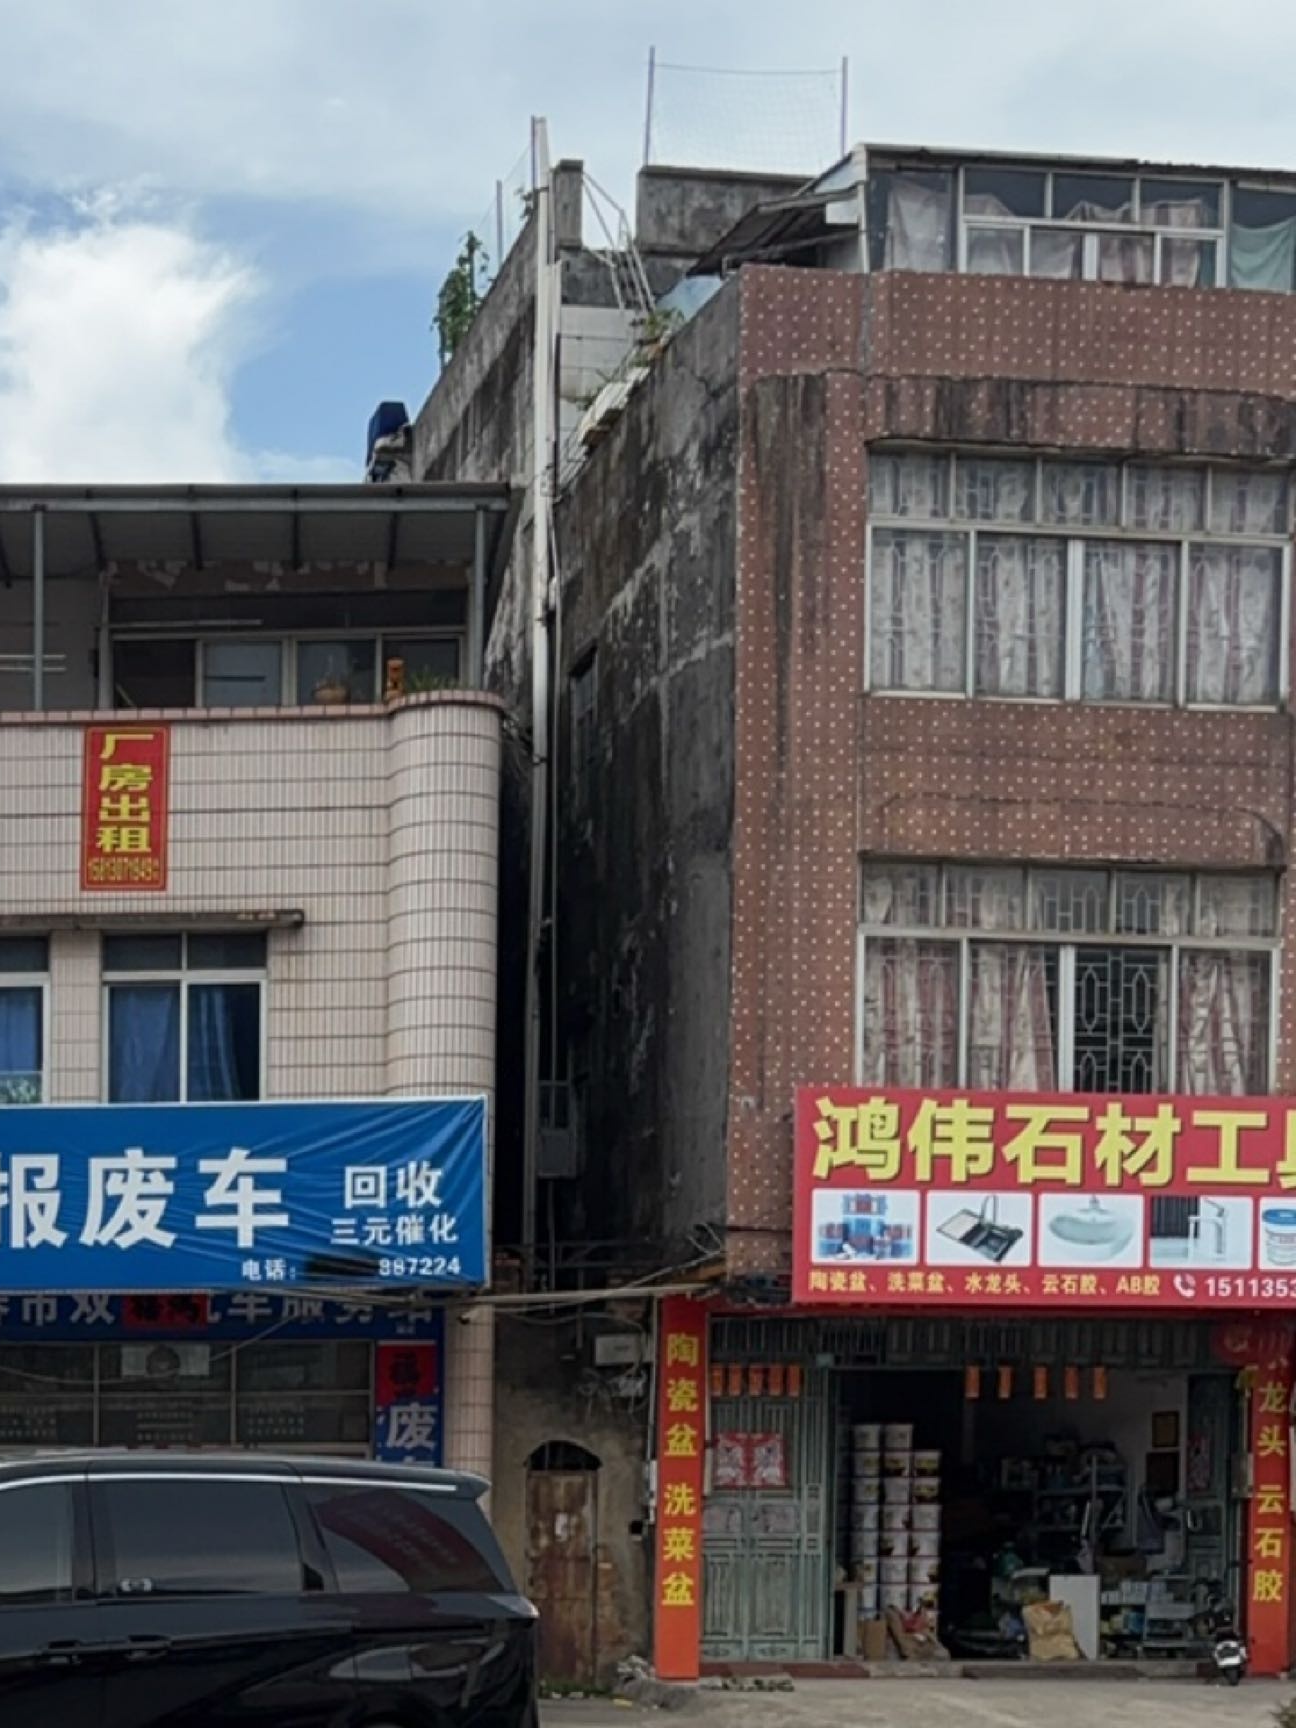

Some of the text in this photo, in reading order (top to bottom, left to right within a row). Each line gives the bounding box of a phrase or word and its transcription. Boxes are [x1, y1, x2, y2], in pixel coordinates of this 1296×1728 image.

[97, 733, 155, 853] 厂房出租
[344, 1160, 443, 1209] 回收
[812, 1096, 1296, 1188] 鸿伟石材工
[330, 1214, 459, 1246] 三元催化
[661, 1333, 700, 1607] 陶瓷盆 洗菜盆
[1253, 1483, 1285, 1602] 云石胶
